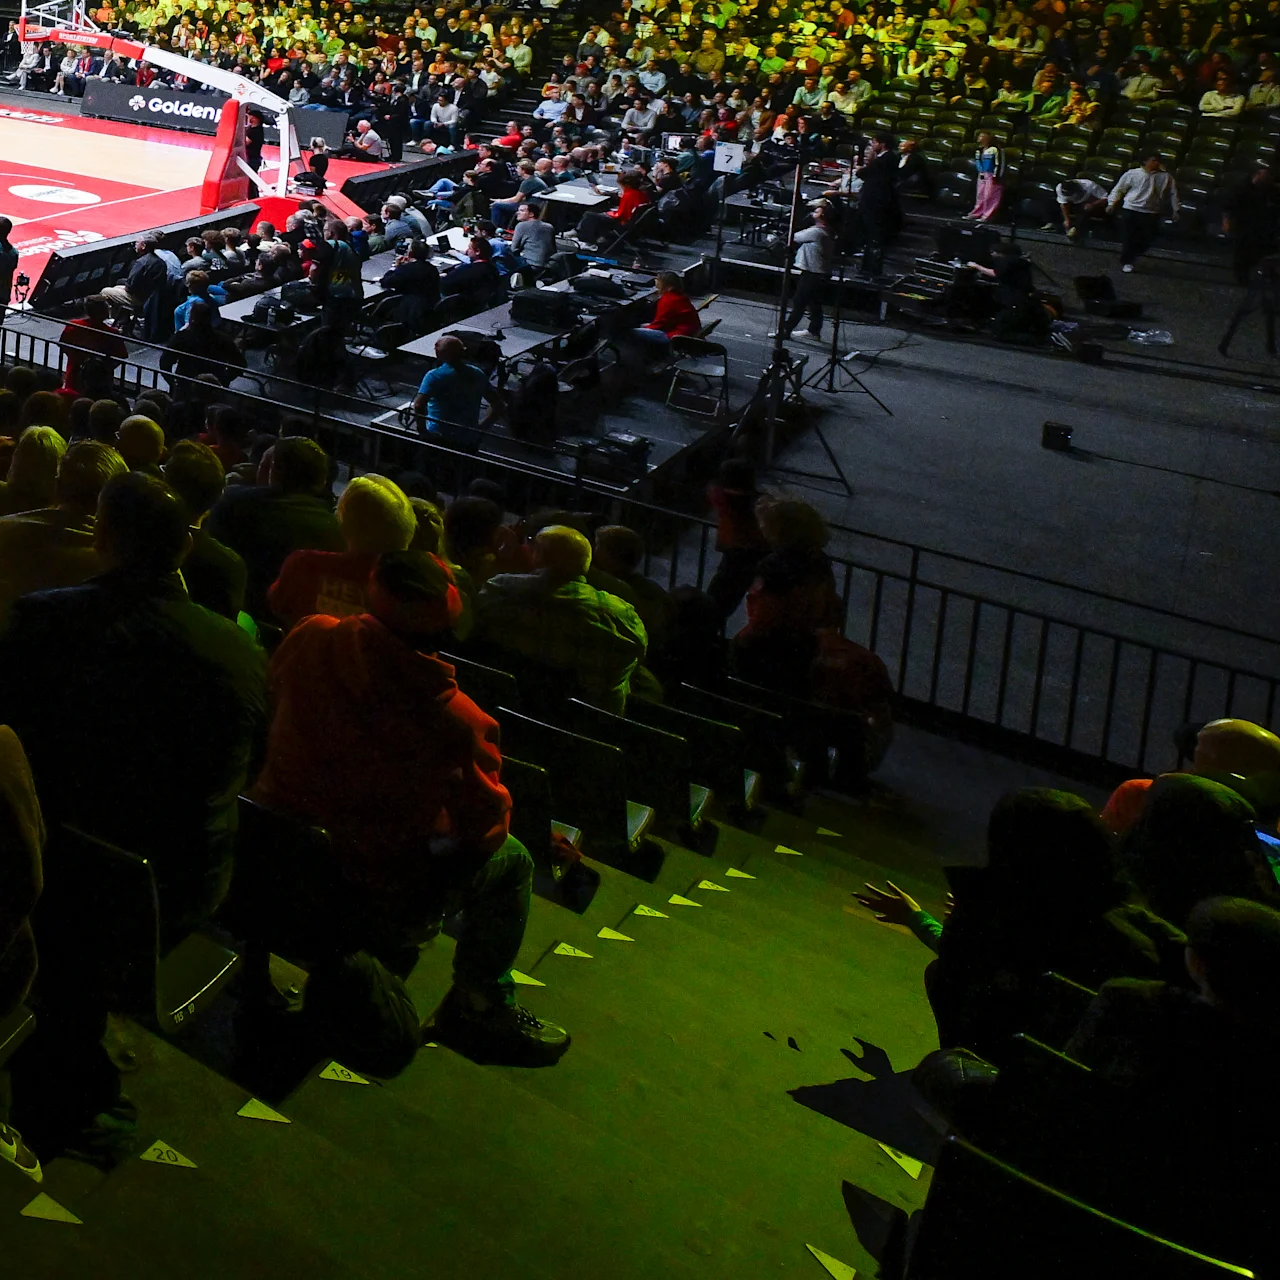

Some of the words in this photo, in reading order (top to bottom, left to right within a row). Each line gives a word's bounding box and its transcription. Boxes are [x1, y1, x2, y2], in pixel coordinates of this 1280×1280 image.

[725, 154, 733, 164] 7
[561, 946, 577, 955] 17
[331, 1067, 352, 1080] 19
[153, 1147, 178, 1162] 20
